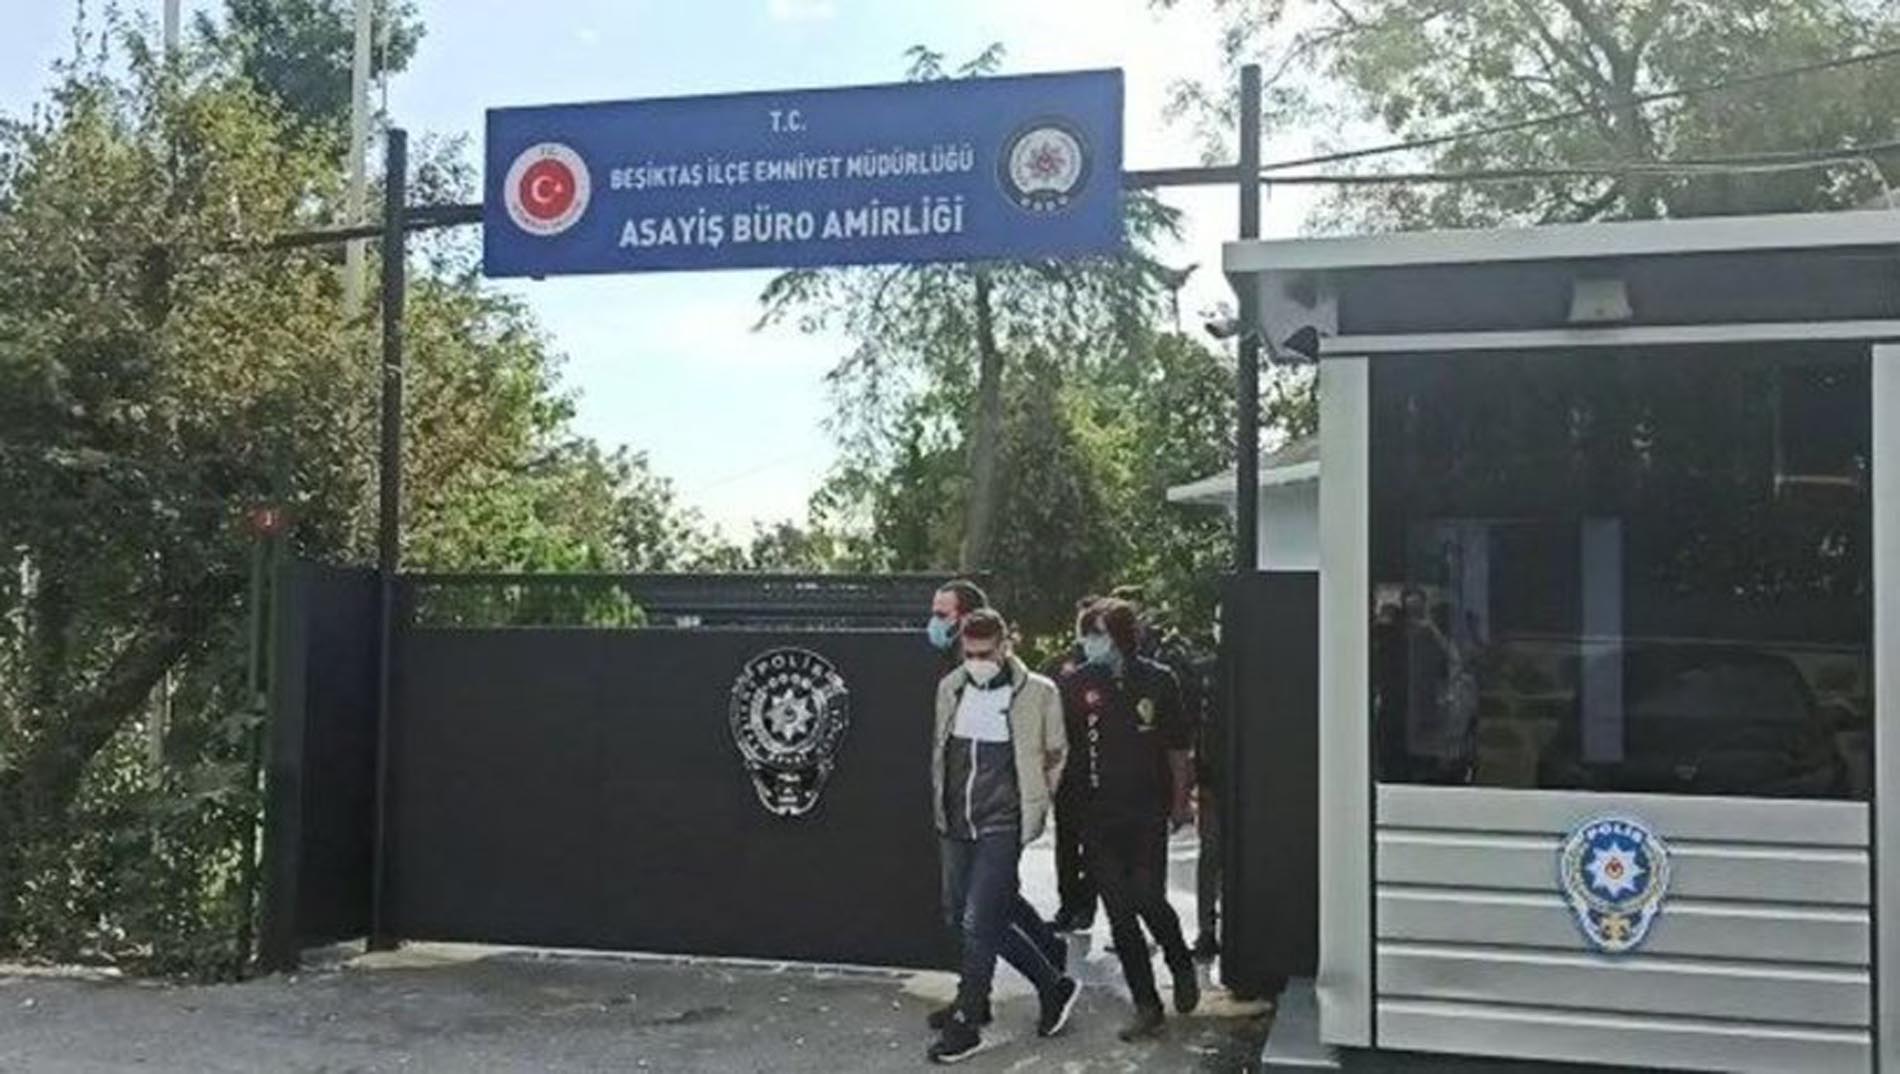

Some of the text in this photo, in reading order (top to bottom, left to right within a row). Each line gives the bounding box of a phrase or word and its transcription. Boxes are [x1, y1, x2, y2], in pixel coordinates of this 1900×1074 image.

[769, 109, 807, 133] T.C.
[610, 142, 974, 190] BEŞİKTAŞ İLÇE EMNİYET MÜDÜRLÜĞÜ
[618, 207, 725, 249] ASAYİŞ
[731, 204, 815, 243] BÜRO
[821, 195, 963, 240] AMİRLİĞİ
